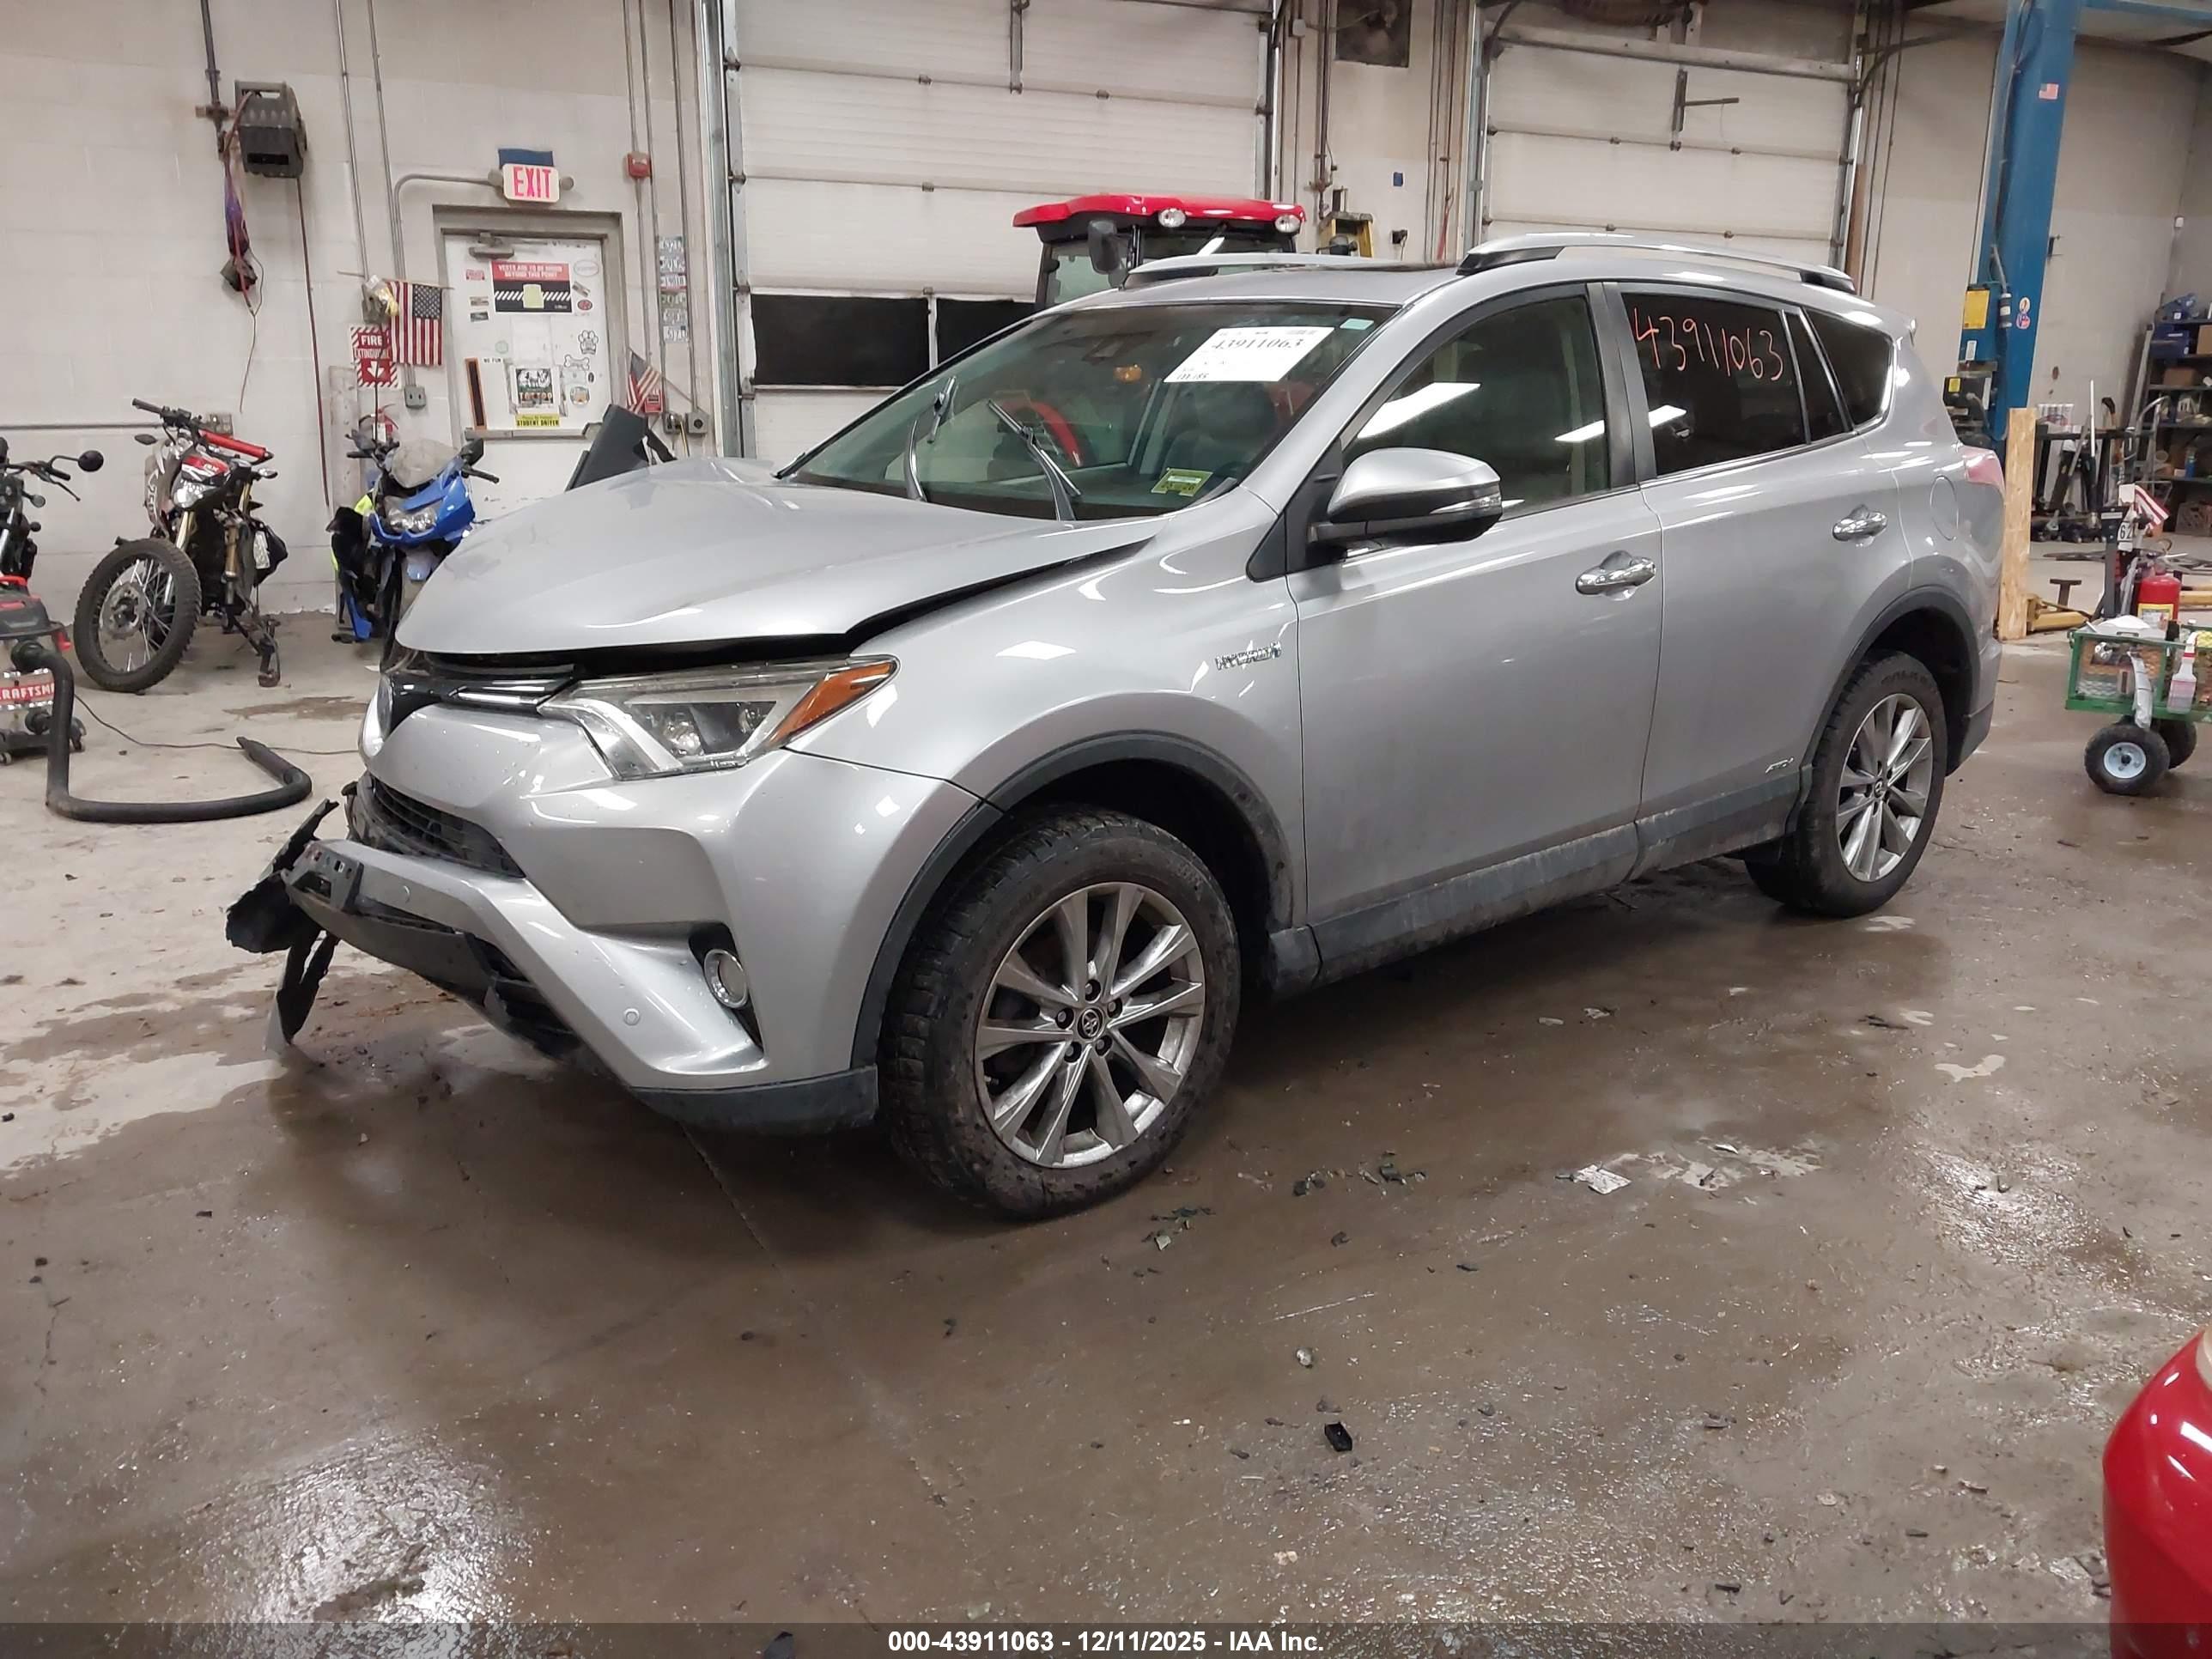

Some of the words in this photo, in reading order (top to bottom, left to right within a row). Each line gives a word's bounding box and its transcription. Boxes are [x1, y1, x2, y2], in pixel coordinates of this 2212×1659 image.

[514, 166, 551, 198] EXIT
[361, 335, 383, 346] FIRE
[1212, 339, 1305, 349] 43911063
[1634, 307, 1784, 381] 43911063
[519, 392, 553, 400] TATTOO
[0, 683, 55, 701] RAFTSM
